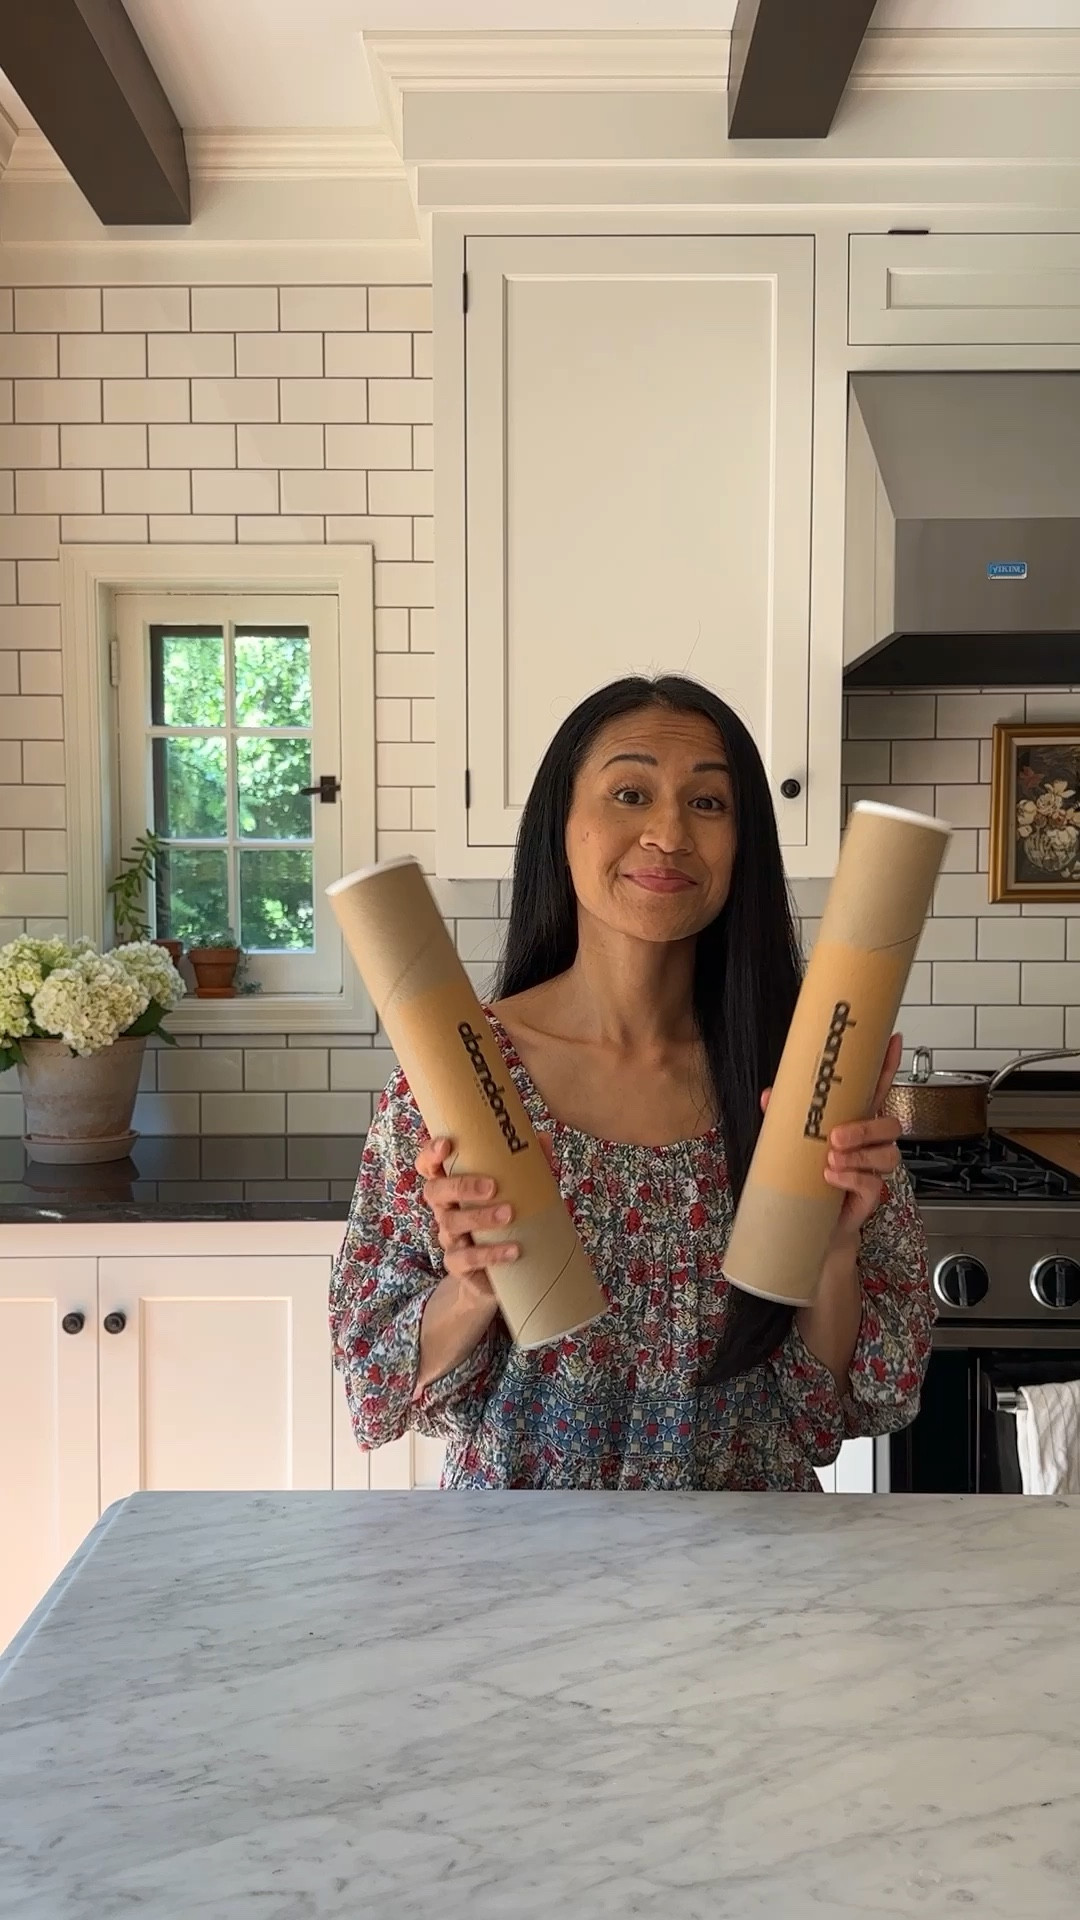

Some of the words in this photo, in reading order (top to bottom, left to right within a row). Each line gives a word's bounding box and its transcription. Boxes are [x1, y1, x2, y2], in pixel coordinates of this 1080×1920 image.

[992, 565, 1025, 574] VIKING
[458, 1021, 529, 1155] abandoned
[804, 1000, 857, 1141] abandoned
